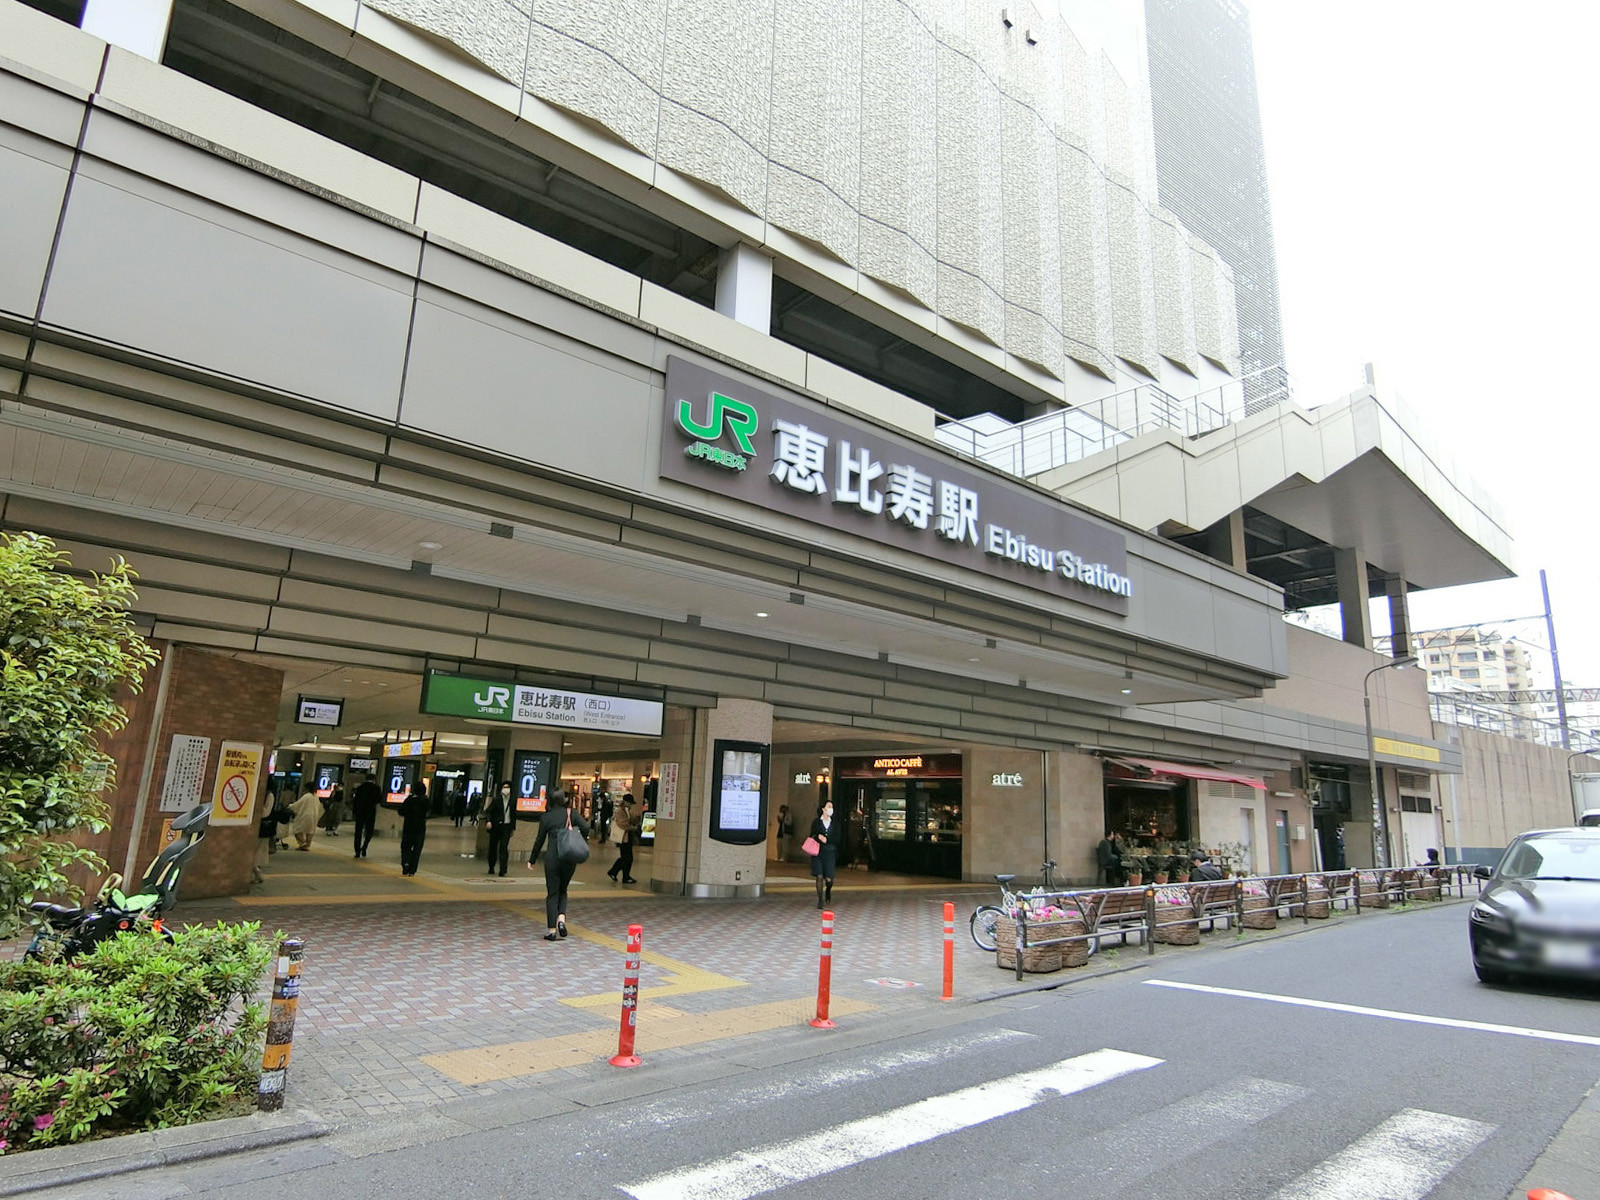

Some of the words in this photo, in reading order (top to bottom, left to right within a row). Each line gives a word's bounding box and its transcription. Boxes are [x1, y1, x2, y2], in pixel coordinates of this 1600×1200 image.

[674, 391, 759, 457] JR
[687, 440, 748, 472] JR東日本
[771, 418, 980, 547] 恵比寿駅
[985, 522, 1055, 573] Ebisu
[1056, 549, 1133, 598] Station
[473, 685, 510, 708] JR
[519, 690, 576, 711] 恵比寿駅
[518, 708, 543, 719] Ebisu
[545, 711, 576, 722] Station
[874, 758, 900, 768] ANTICO
[900, 756, 923, 768] CAFFÈ
[390, 776, 402, 791] 0
[521, 774, 535, 795] 0
[991, 772, 1024, 786] atré
